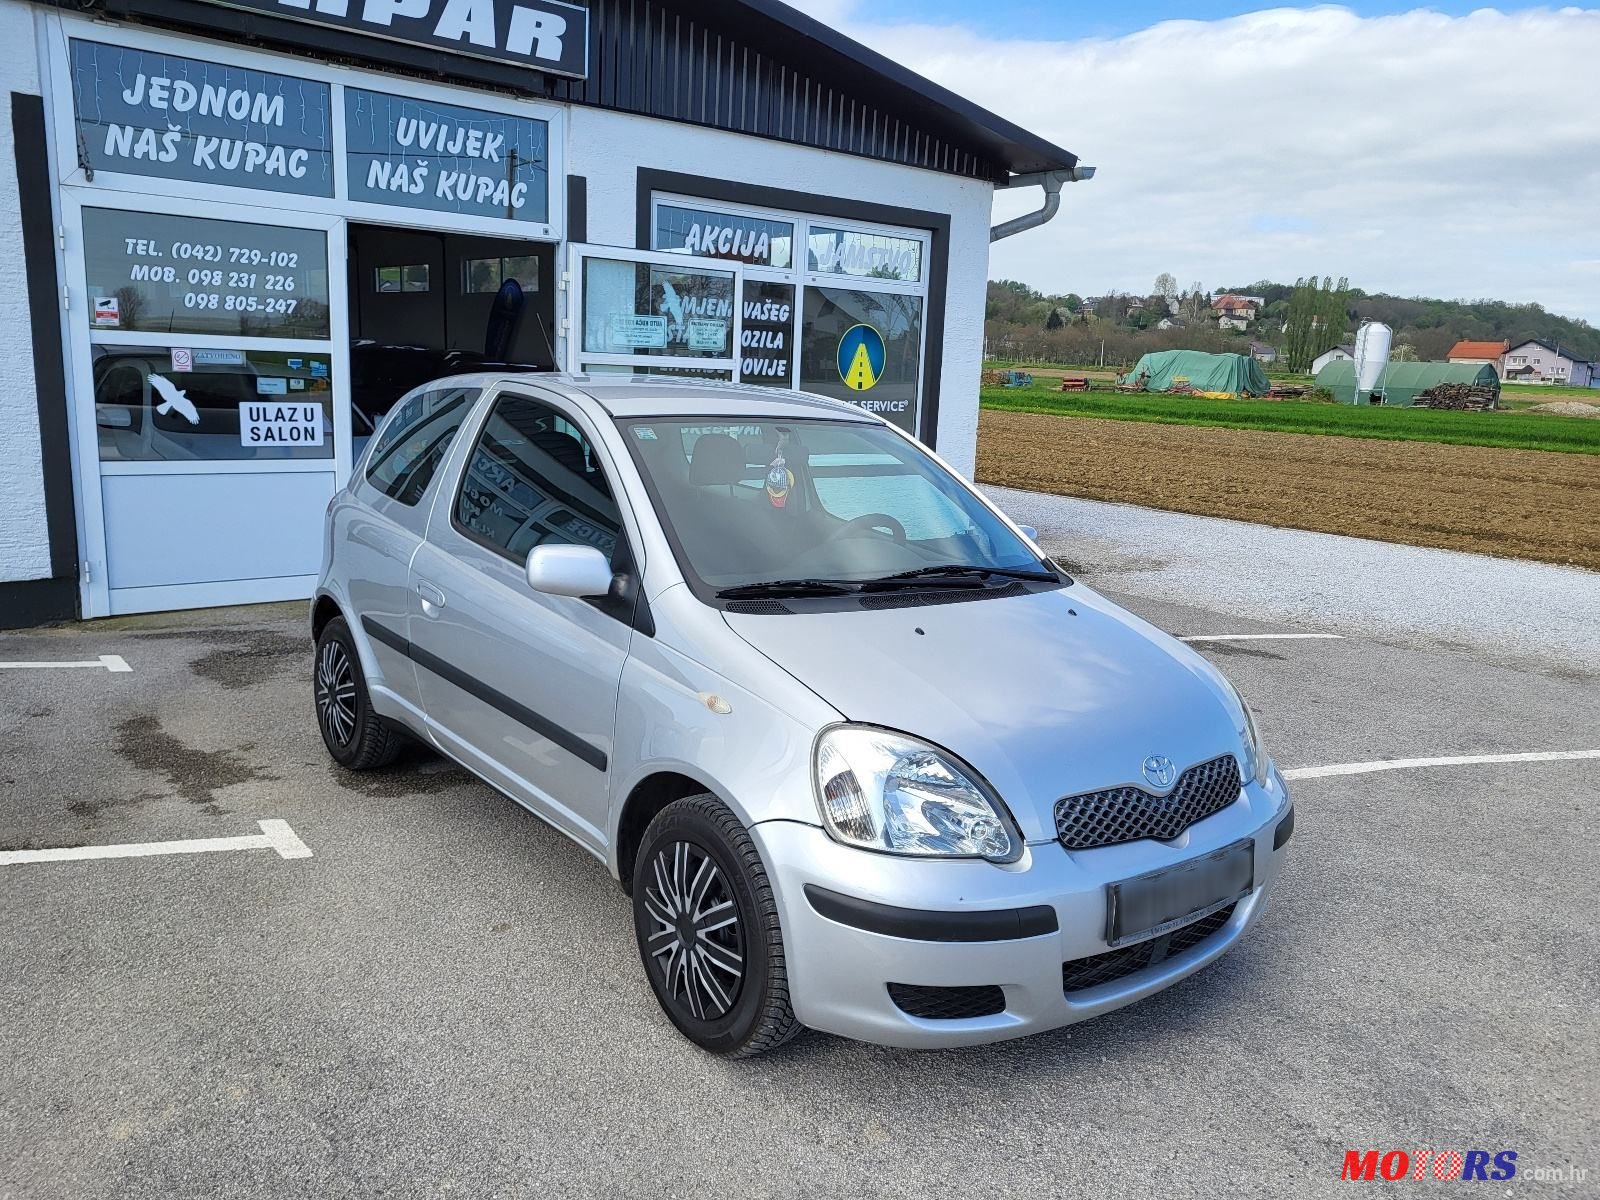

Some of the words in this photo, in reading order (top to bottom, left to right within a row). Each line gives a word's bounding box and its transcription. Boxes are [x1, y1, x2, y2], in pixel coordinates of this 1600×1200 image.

[122, 73, 284, 127] JEDNOM
[103, 122, 182, 163] NAŠ
[193, 134, 309, 179] KUPAC
[396, 116, 504, 163] UVIJEK
[366, 158, 429, 195] NAŠ
[435, 170, 528, 209] KUPAC
[125, 238, 163, 257] TEL.
[171, 241, 223, 262] (042)
[229, 247, 298, 268] 729-102
[684, 222, 769, 260] AKCIJA
[819, 240, 912, 275] JAMSTVO
[130, 264, 181, 284] MOB.
[188, 268, 223, 287] 098
[228, 271, 257, 289] 231
[264, 274, 295, 291] 226
[184, 292, 219, 310] 098
[224, 295, 298, 314] 805-247
[743, 299, 790, 323] VAŠEG
[741, 329, 784, 349] OZILA
[249, 407, 298, 422] ULAZ
[303, 407, 315, 422] U
[250, 426, 316, 442] SALON
